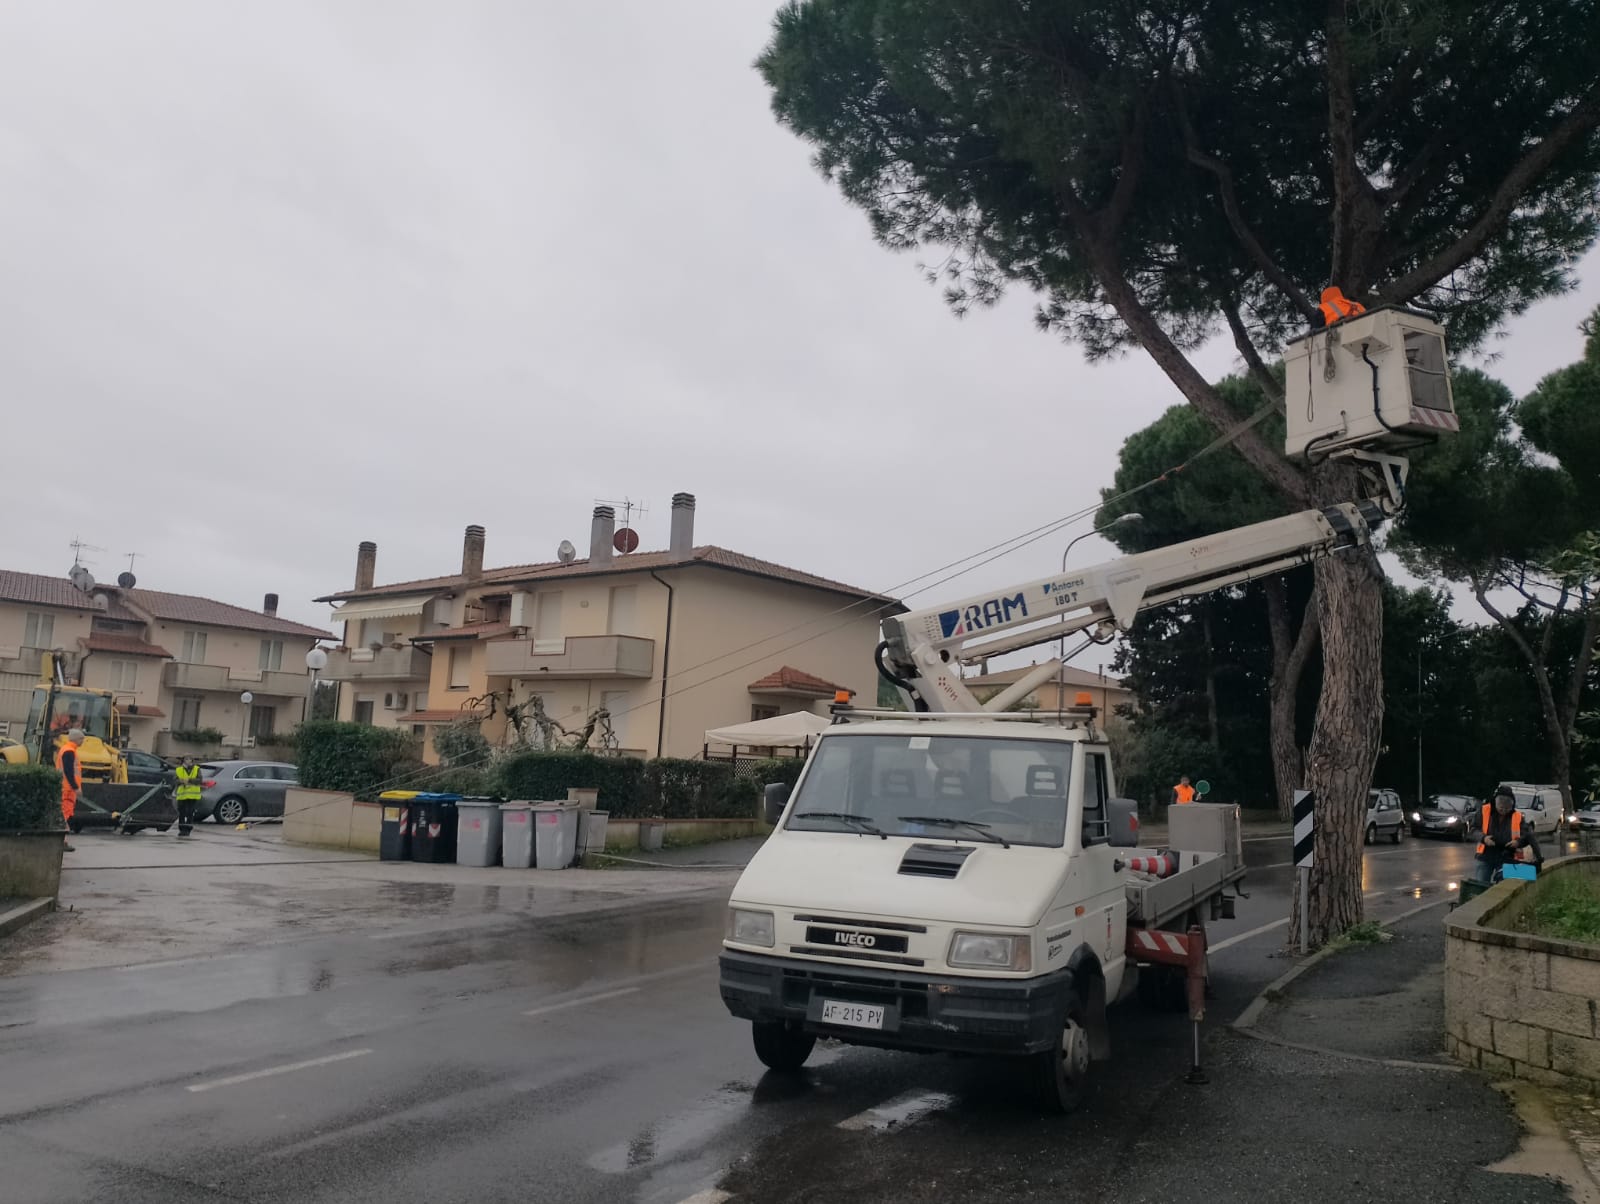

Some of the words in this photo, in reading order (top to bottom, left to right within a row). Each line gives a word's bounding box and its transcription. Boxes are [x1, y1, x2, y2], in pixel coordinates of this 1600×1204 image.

[1051, 578, 1085, 593] Antares
[964, 592, 1029, 632] RAM
[834, 931, 876, 947] IVECO
[823, 1005, 838, 1019] AF
[842, 1007, 864, 1022] 215
[867, 1010, 882, 1024] PV
